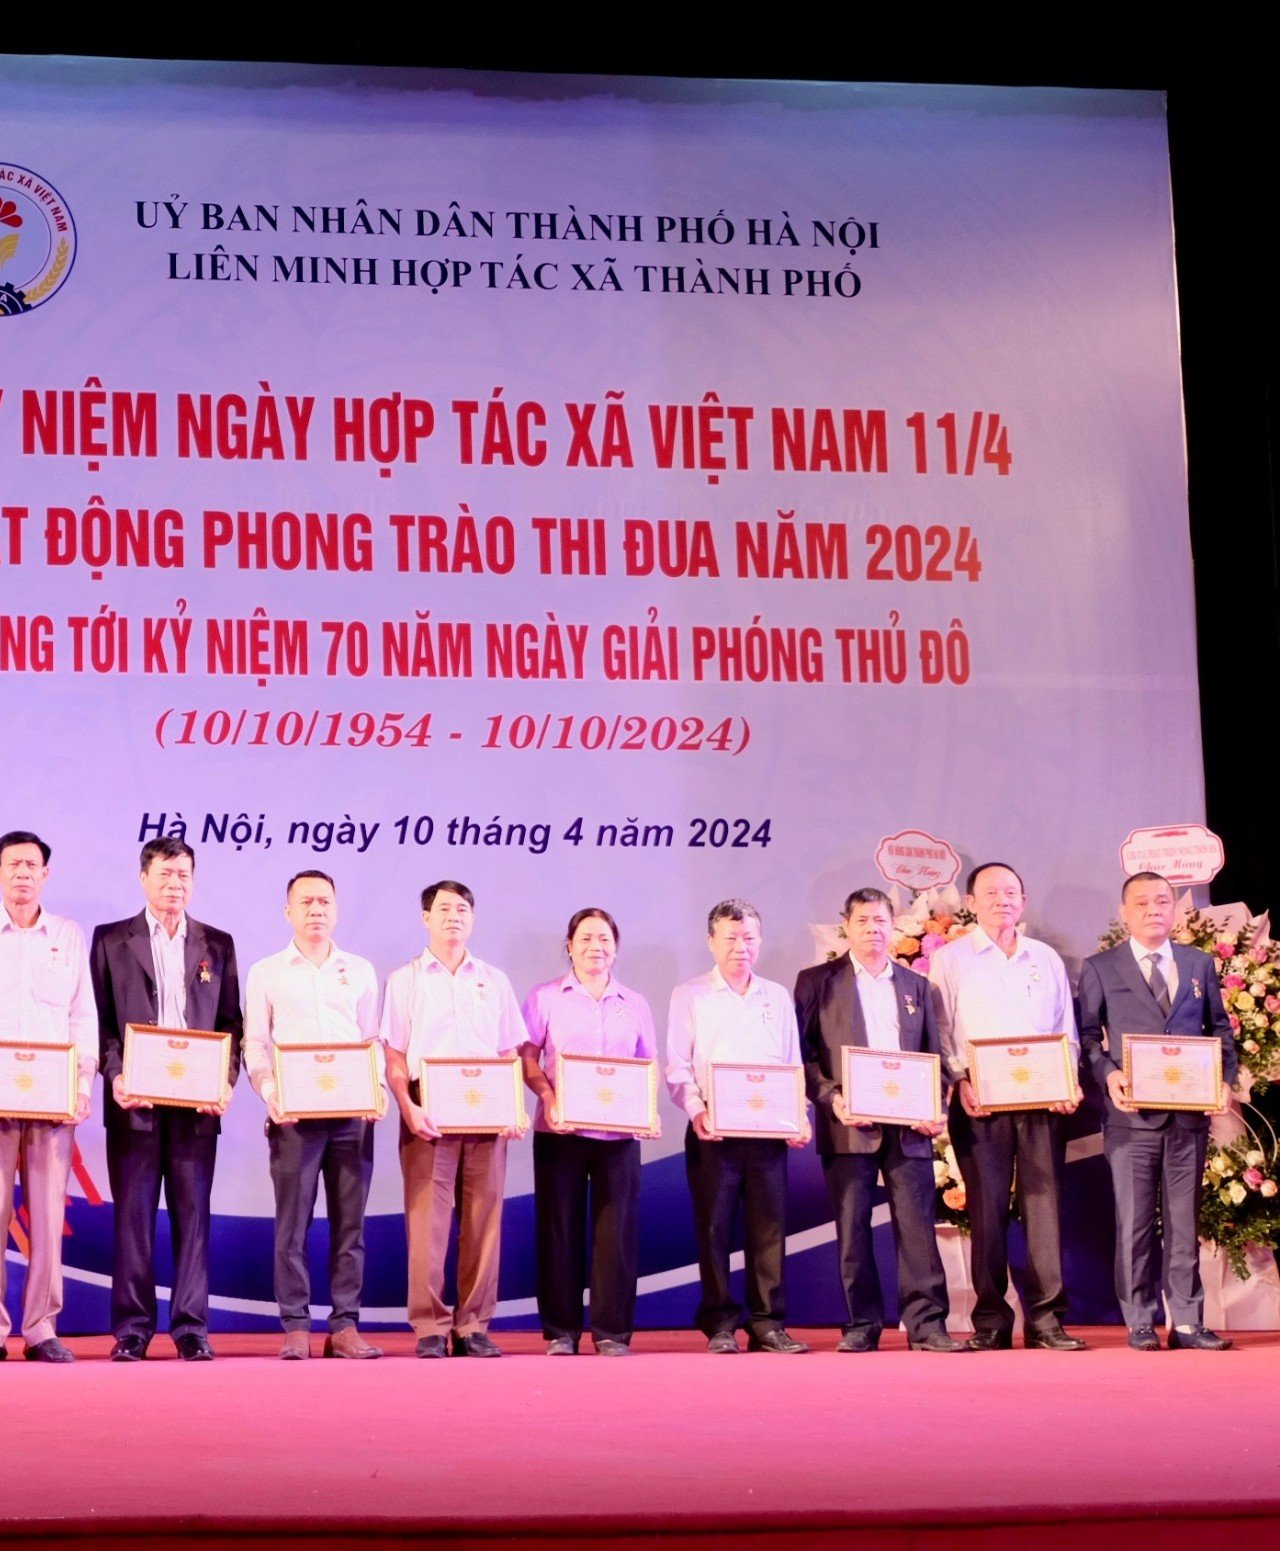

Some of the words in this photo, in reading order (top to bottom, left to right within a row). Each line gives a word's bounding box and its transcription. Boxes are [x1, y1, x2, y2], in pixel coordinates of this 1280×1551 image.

[33, 184, 55, 206] VIỆT
[51, 206, 68, 232] NAM
[136, 194, 188, 228] UỶ
[202, 204, 278, 231] BAN
[293, 199, 401, 234] NHÂN
[417, 201, 494, 237] DÂN
[506, 205, 642, 241] THÀNH
[657, 210, 734, 244] PHỐ
[748, 211, 799, 246] HÀ
[812, 217, 878, 255] NỘI
[169, 245, 258, 281] LIÊN
[274, 256, 377, 284] MINH
[393, 259, 471, 294] HỢP
[480, 254, 557, 289] TÁC
[572, 258, 622, 291] XÃ
[634, 259, 769, 295] THÀNH
[783, 263, 861, 297] PHỐ
[23, 377, 157, 471] NIỆM
[178, 381, 314, 460] NGÀY
[334, 392, 434, 477] HỢP
[453, 387, 546, 466] TÁC
[566, 391, 633, 467] XÃ
[649, 392, 753, 484] VIỆT
[772, 408, 887, 472] NAM
[907, 412, 1011, 475] 11/4
[45, 496, 183, 580] ĐỘNG
[204, 511, 372, 571] PHONG
[390, 504, 514, 574] TRÀO
[532, 518, 606, 575] THI
[623, 520, 719, 577] ĐUA
[736, 510, 848, 579] NĂM
[866, 525, 981, 581] 2024
[68, 605, 127, 672] TỚI
[144, 599, 192, 673] KỶ
[207, 608, 307, 686] NIỆM
[322, 622, 368, 676] 70
[383, 611, 472, 677] NĂM
[487, 612, 588, 679] NGÀY
[603, 607, 678, 680] GIẢI
[693, 616, 823, 682] PHÓNG
[836, 611, 906, 684] THỦ
[920, 619, 969, 684] ĐÔ
[156, 709, 431, 748] (10/10/1954
[482, 714, 750, 755] 10/10/2024)
[138, 812, 187, 842] Hà
[201, 813, 272, 850] Nội,
[288, 814, 379, 852] ngày
[395, 816, 433, 845] 10
[448, 816, 550, 854] tháng
[564, 818, 583, 845] 4
[597, 818, 673, 846] năm
[689, 819, 771, 847] 2024
